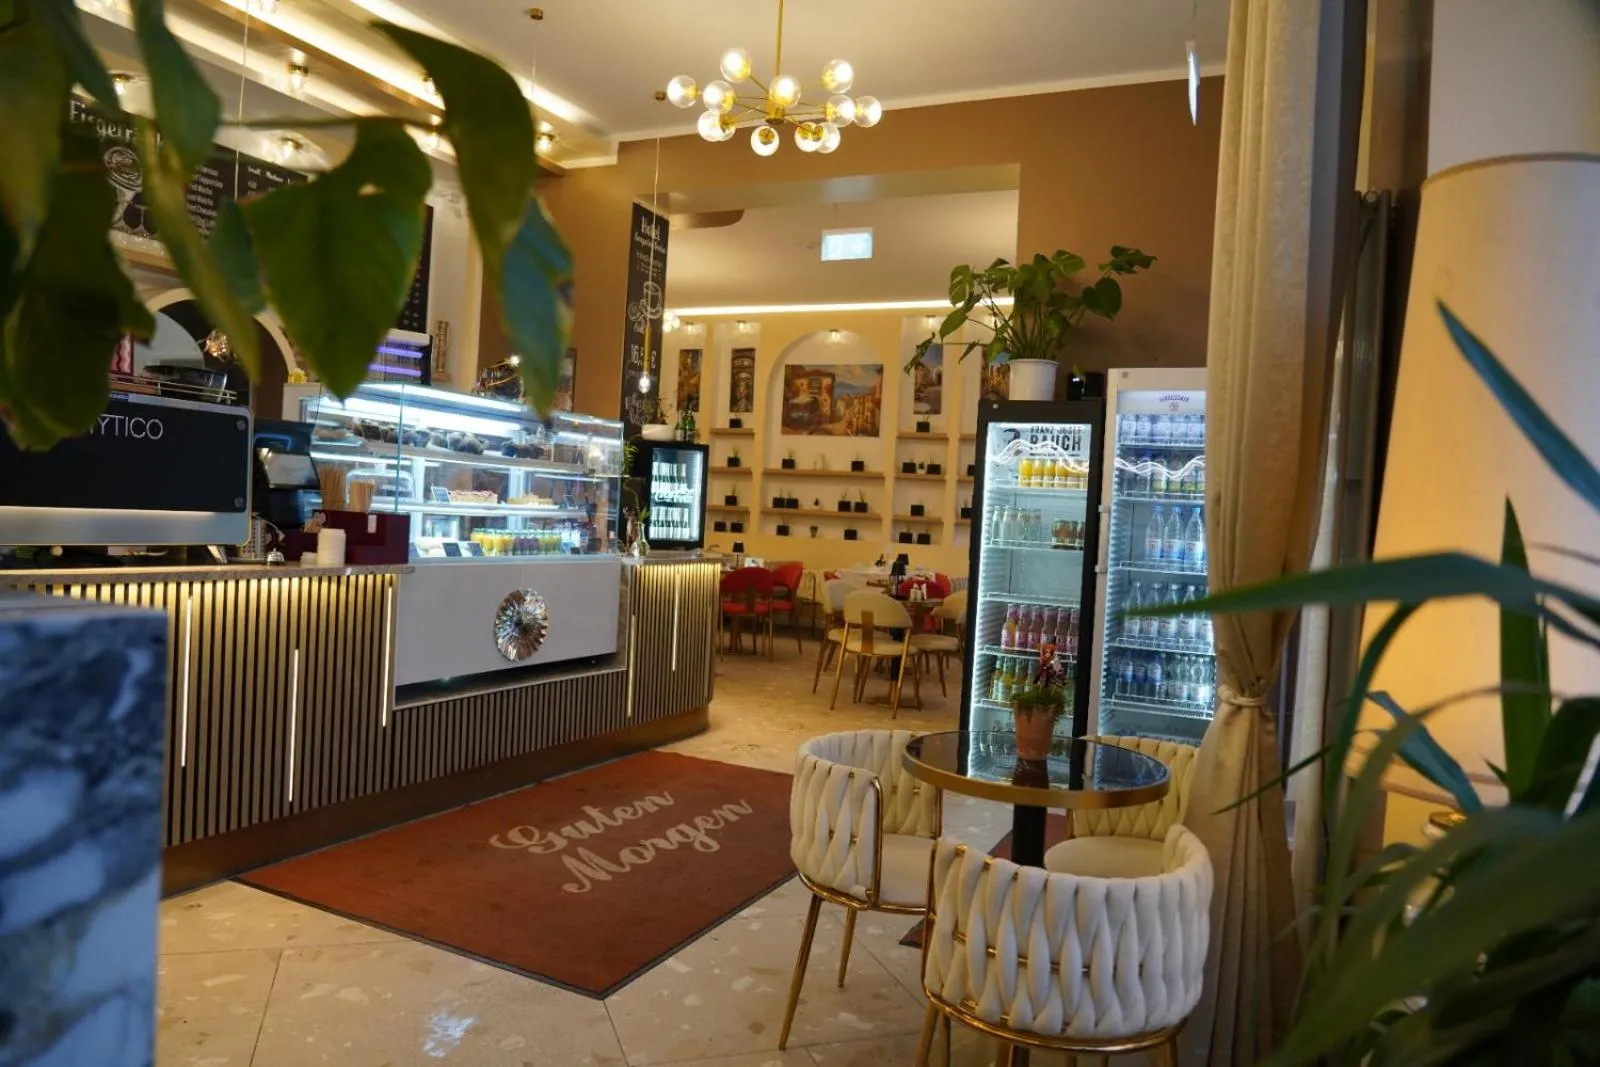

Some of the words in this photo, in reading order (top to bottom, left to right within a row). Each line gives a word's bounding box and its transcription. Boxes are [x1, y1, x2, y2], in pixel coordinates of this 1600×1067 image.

[90, 413, 164, 440] YTICO
[1030, 434, 1082, 452] RAUCH
[489, 791, 675, 854] Guten
[561, 799, 754, 893] Morgen
